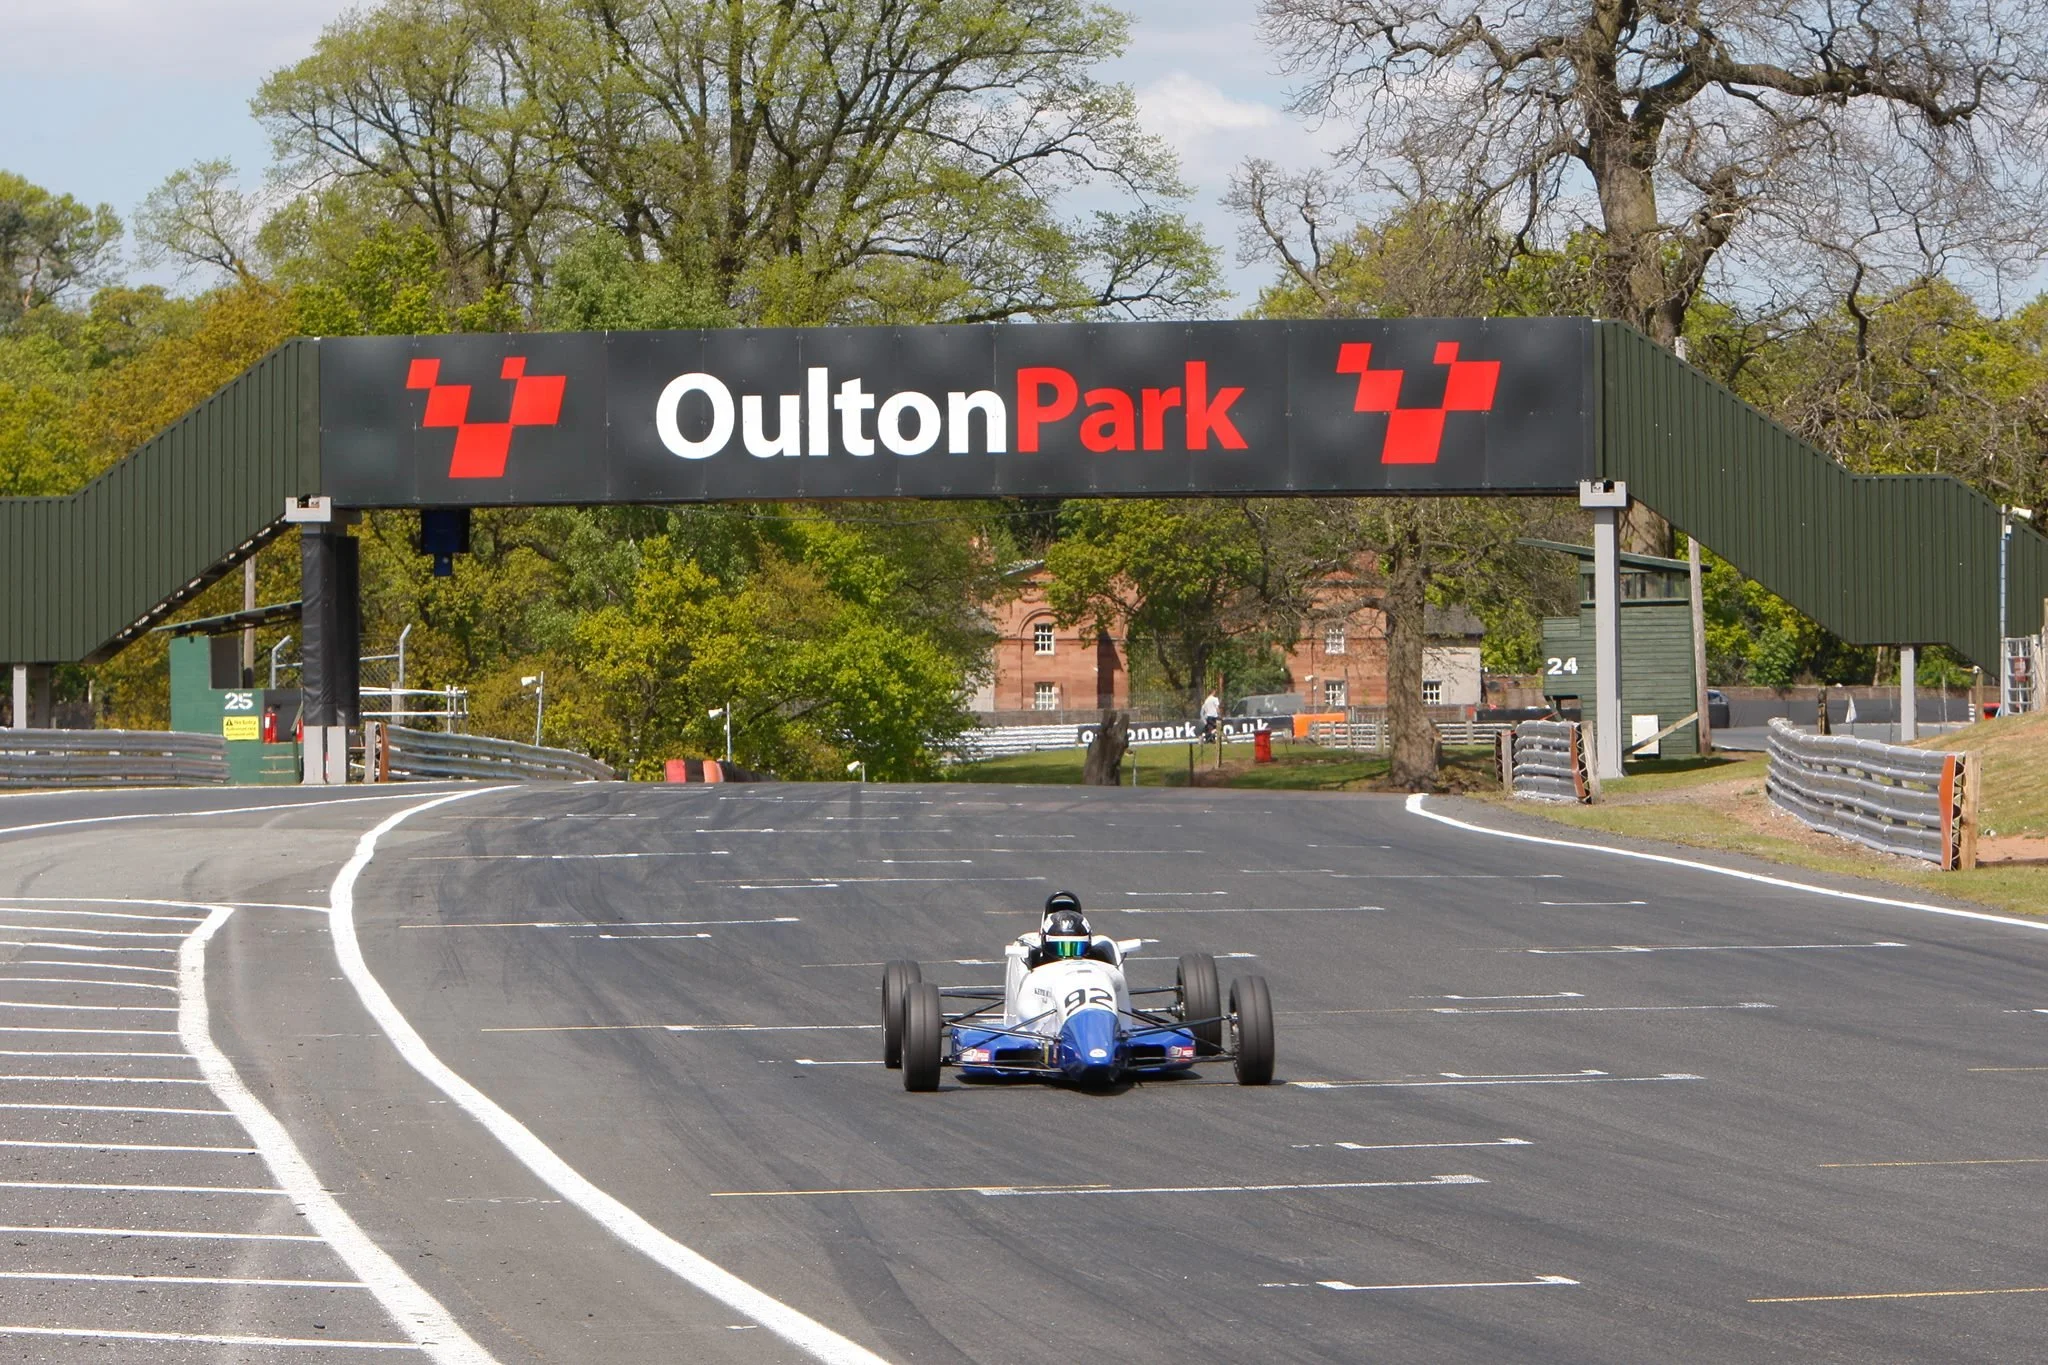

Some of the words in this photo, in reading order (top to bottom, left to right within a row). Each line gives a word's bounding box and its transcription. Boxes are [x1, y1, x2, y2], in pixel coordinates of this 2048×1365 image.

[655, 360, 1250, 459] OultonPark
[1547, 656, 1578, 675] 24
[224, 692, 253, 710] 25
[1081, 718, 1269, 743] oonpark.o.uk
[1064, 987, 1113, 1017] 92
